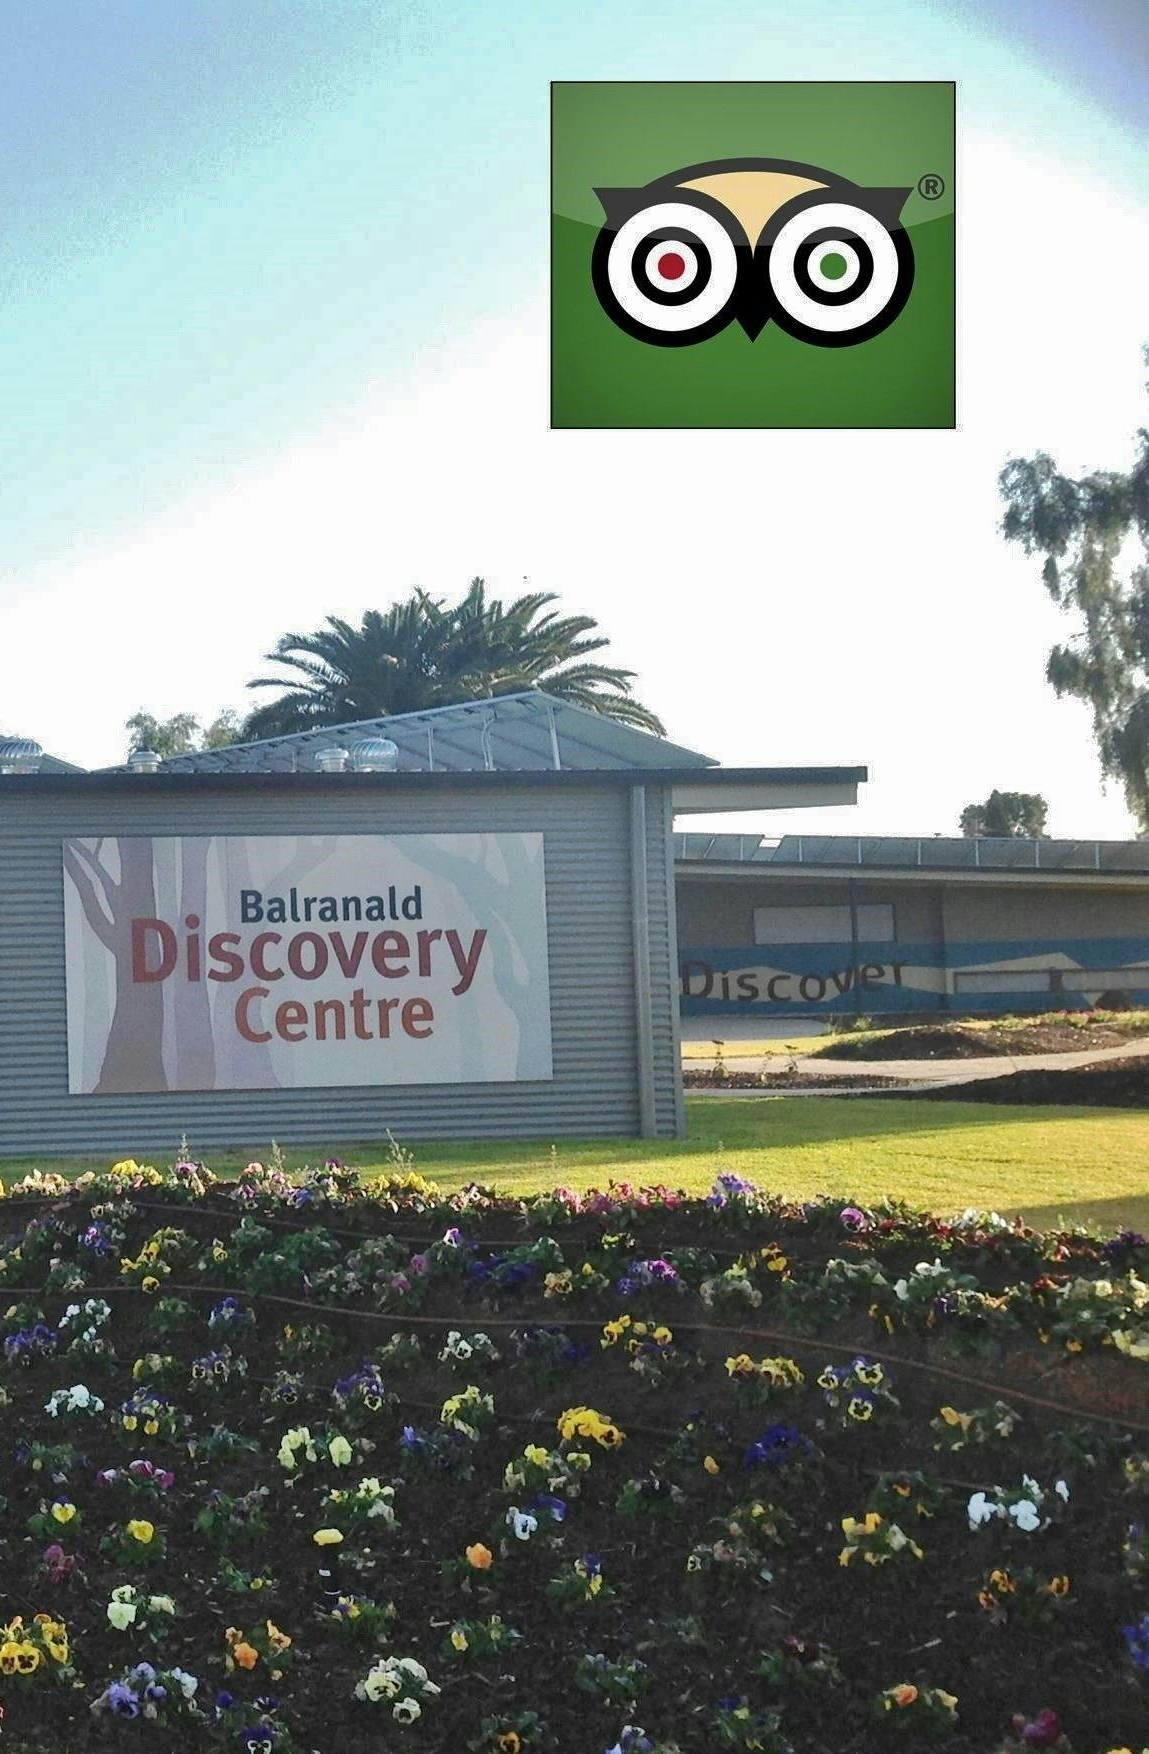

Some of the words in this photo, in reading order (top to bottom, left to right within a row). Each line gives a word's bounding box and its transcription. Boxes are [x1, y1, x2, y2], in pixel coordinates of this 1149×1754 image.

[241, 885, 423, 923] Balranald
[131, 914, 487, 996] Discovery
[682, 959, 908, 1002] Discover
[234, 987, 434, 1043] Centre
